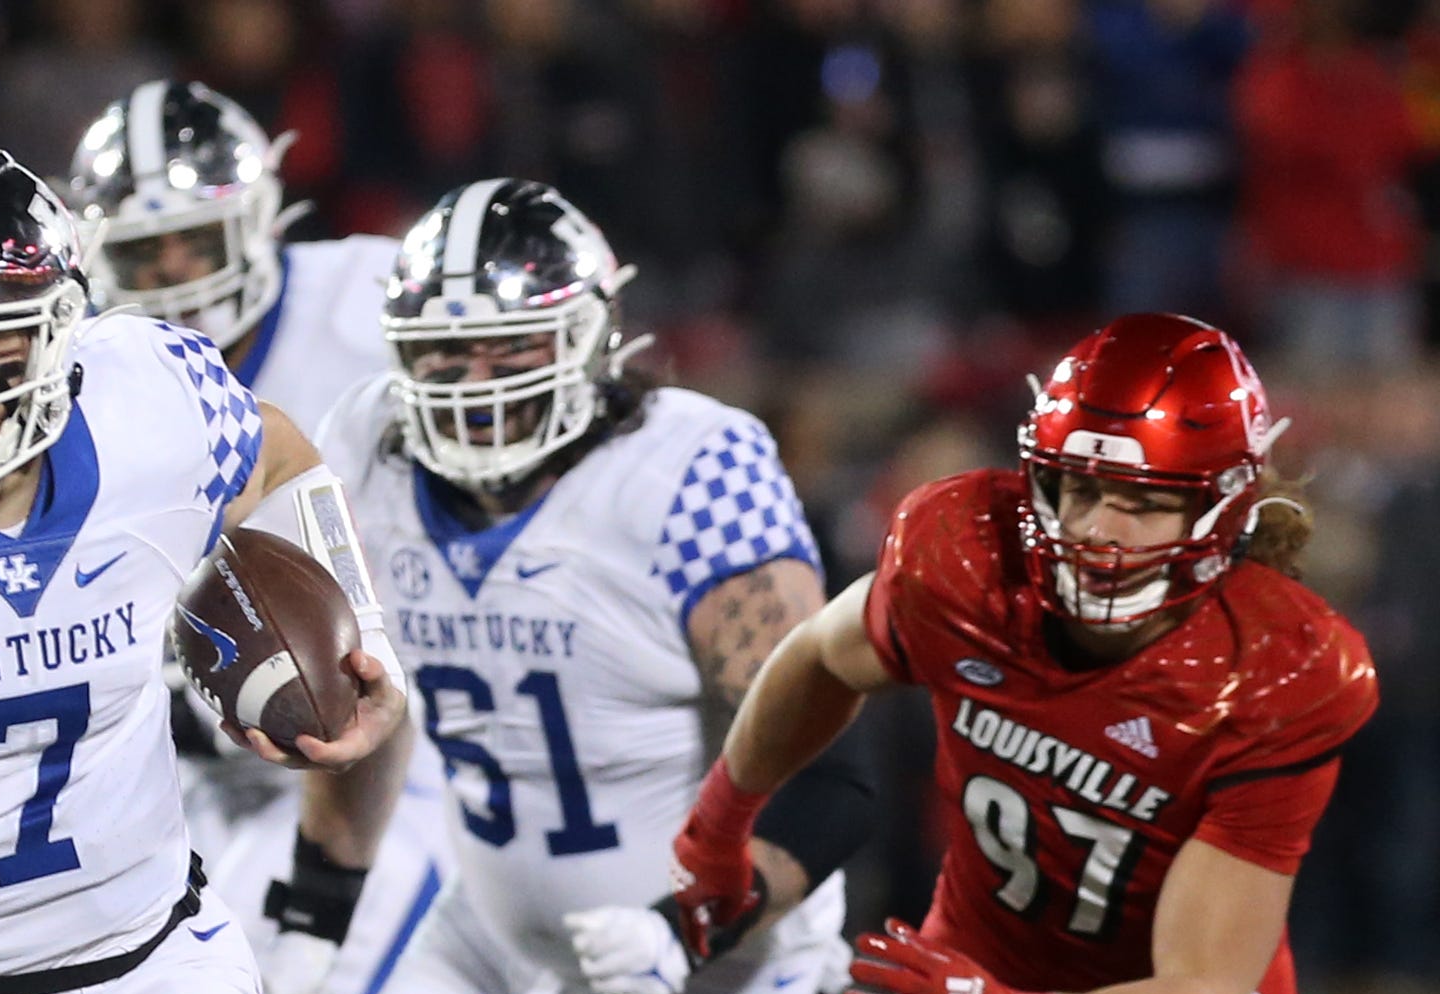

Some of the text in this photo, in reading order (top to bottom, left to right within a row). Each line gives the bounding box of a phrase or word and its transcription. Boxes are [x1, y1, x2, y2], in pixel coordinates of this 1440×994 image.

[397, 608, 577, 657] KENTUCKY
[414, 663, 620, 857] 61
[952, 698, 1171, 820] LOUISVILLE
[963, 775, 1134, 934] 97
